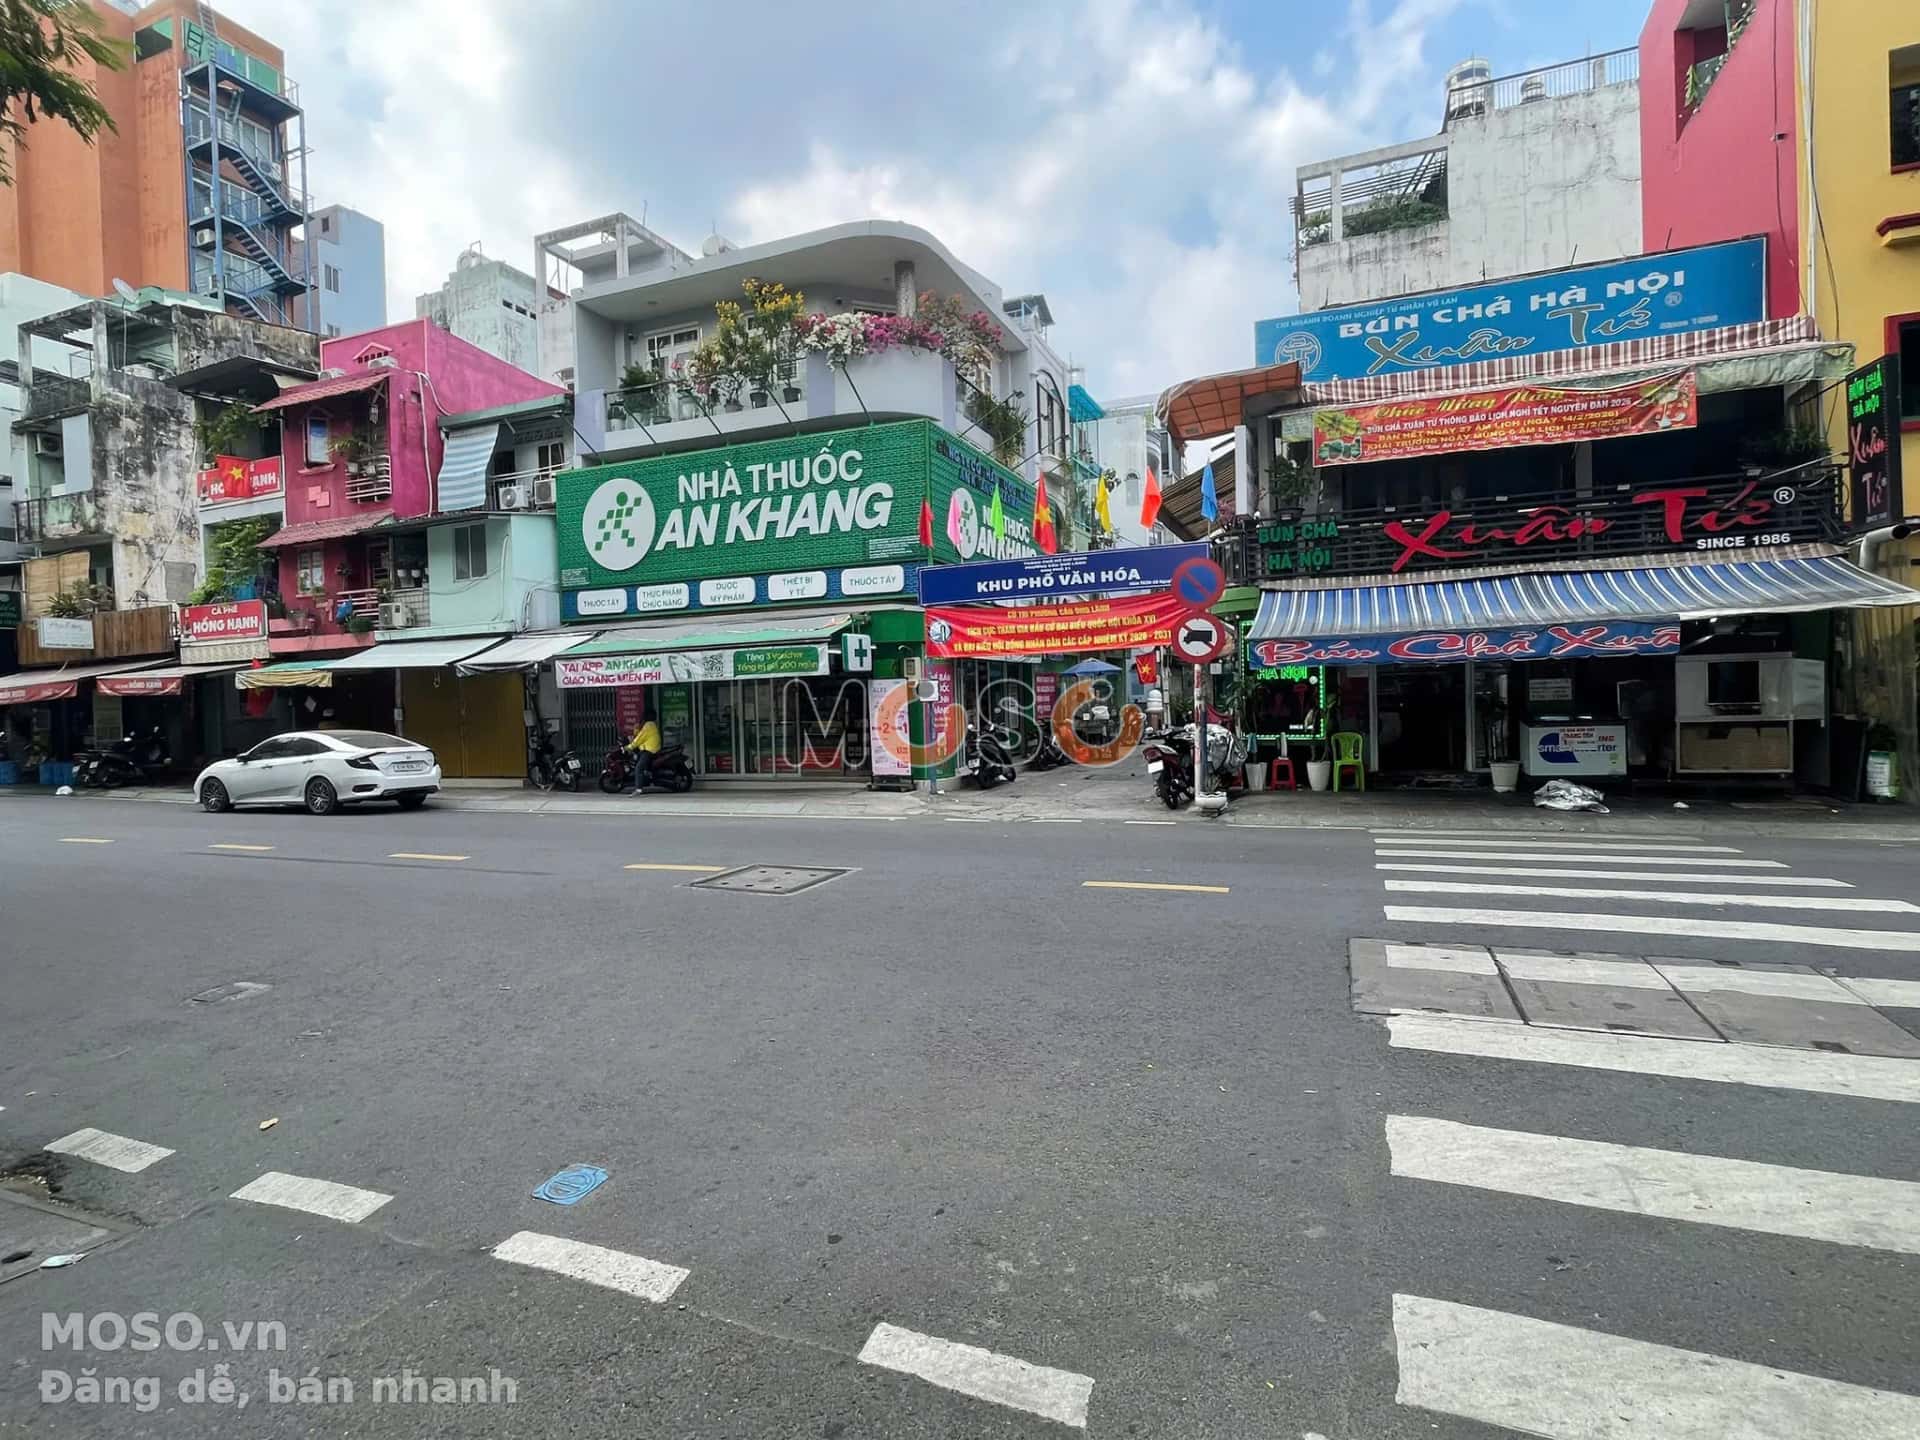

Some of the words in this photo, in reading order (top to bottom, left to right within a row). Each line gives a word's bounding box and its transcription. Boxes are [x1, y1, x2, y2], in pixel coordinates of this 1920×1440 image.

[1339, 314, 1419, 339] BÚN
[1432, 295, 1512, 324] CHẢ
[1529, 285, 1587, 311] HÀ
[1606, 270, 1685, 298] NỘI
[1364, 327, 1535, 375] Xuân
[1403, 419, 1425, 431] XUÂN
[1439, 413, 1467, 426] THÔNG
[1469, 411, 1486, 423] BÁO
[678, 461, 741, 503] NHÀ
[747, 439, 863, 493] THUỐC
[655, 503, 720, 551] AN
[725, 482, 893, 543] KHANG
[1301, 517, 1339, 540] CHẢ
[1384, 506, 1615, 573] Xuân
[1696, 536, 1745, 550] SINCE
[1751, 533, 1790, 546] 1986
[1299, 548, 1331, 571] NỘI
[977, 579, 1013, 593] KHU
[1018, 572, 1054, 590] PHỐ
[1059, 570, 1095, 586] VĂN
[1100, 567, 1141, 583] HÓA
[211, 605, 223, 615] CÀ
[223, 604, 238, 614] PHÊ
[192, 616, 225, 633] HỒNG
[227, 616, 259, 632] HẠNH
[1254, 639, 1380, 666] Bún
[1388, 630, 1539, 658] Chả
[582, 660, 603, 672] APP
[605, 659, 620, 671] AN
[621, 657, 661, 669] KHANG
[562, 675, 585, 686] GIAO
